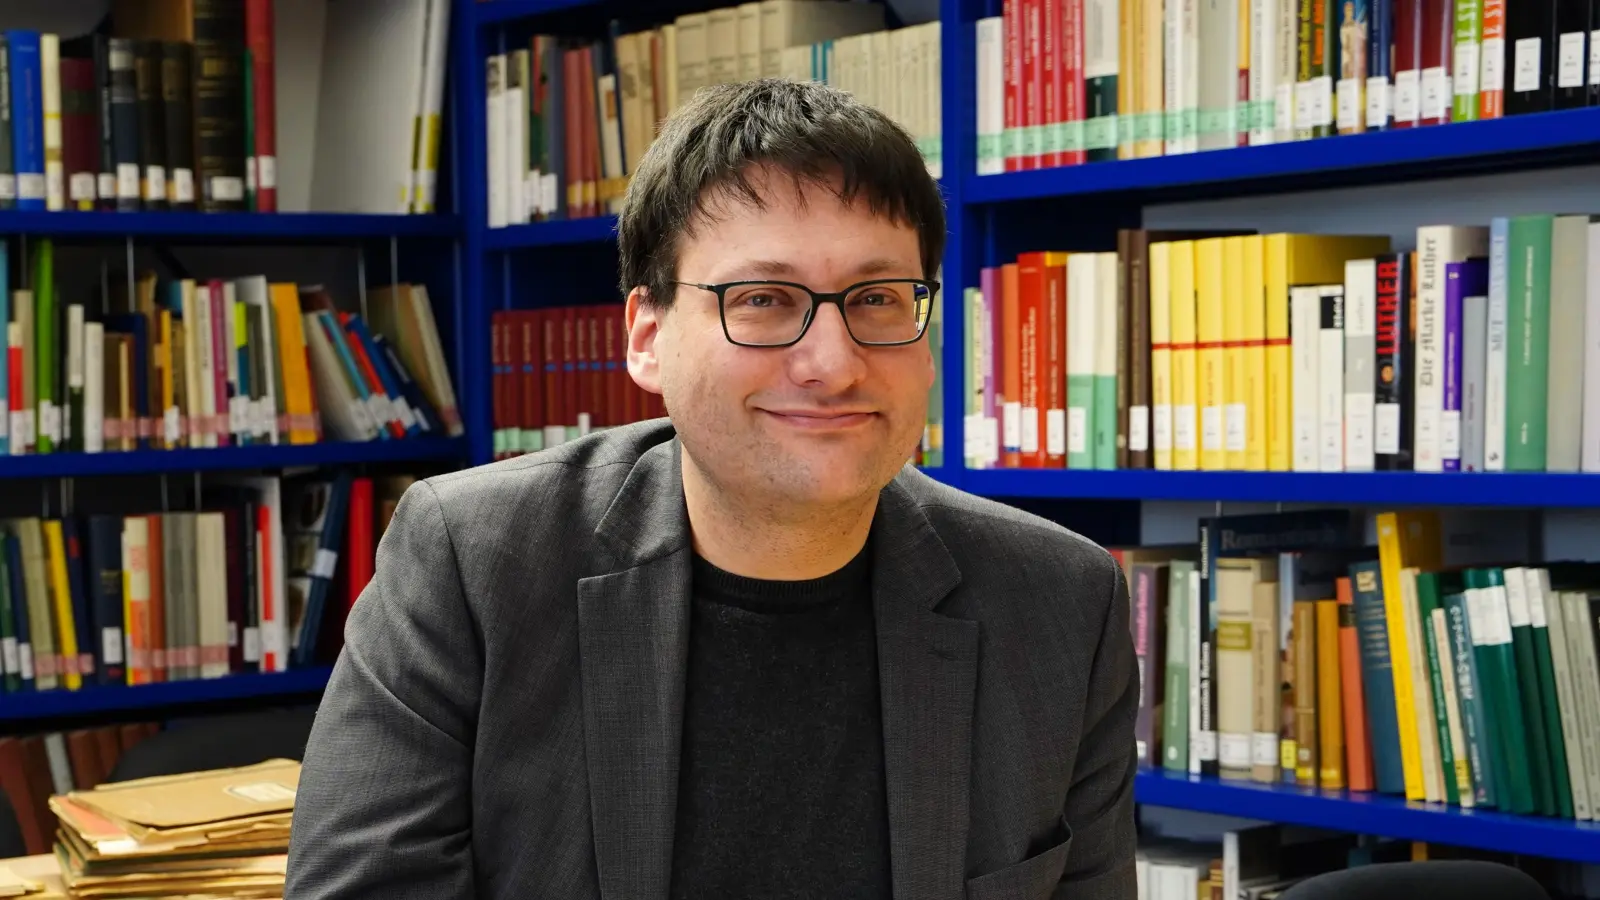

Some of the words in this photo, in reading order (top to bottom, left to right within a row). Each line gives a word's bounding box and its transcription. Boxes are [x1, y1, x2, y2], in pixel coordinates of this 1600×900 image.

[1422, 238, 1437, 290] Luther
[1377, 261, 1400, 354] LUTHER
[1421, 297, 1435, 353] Marke
[1420, 358, 1434, 387] Die
